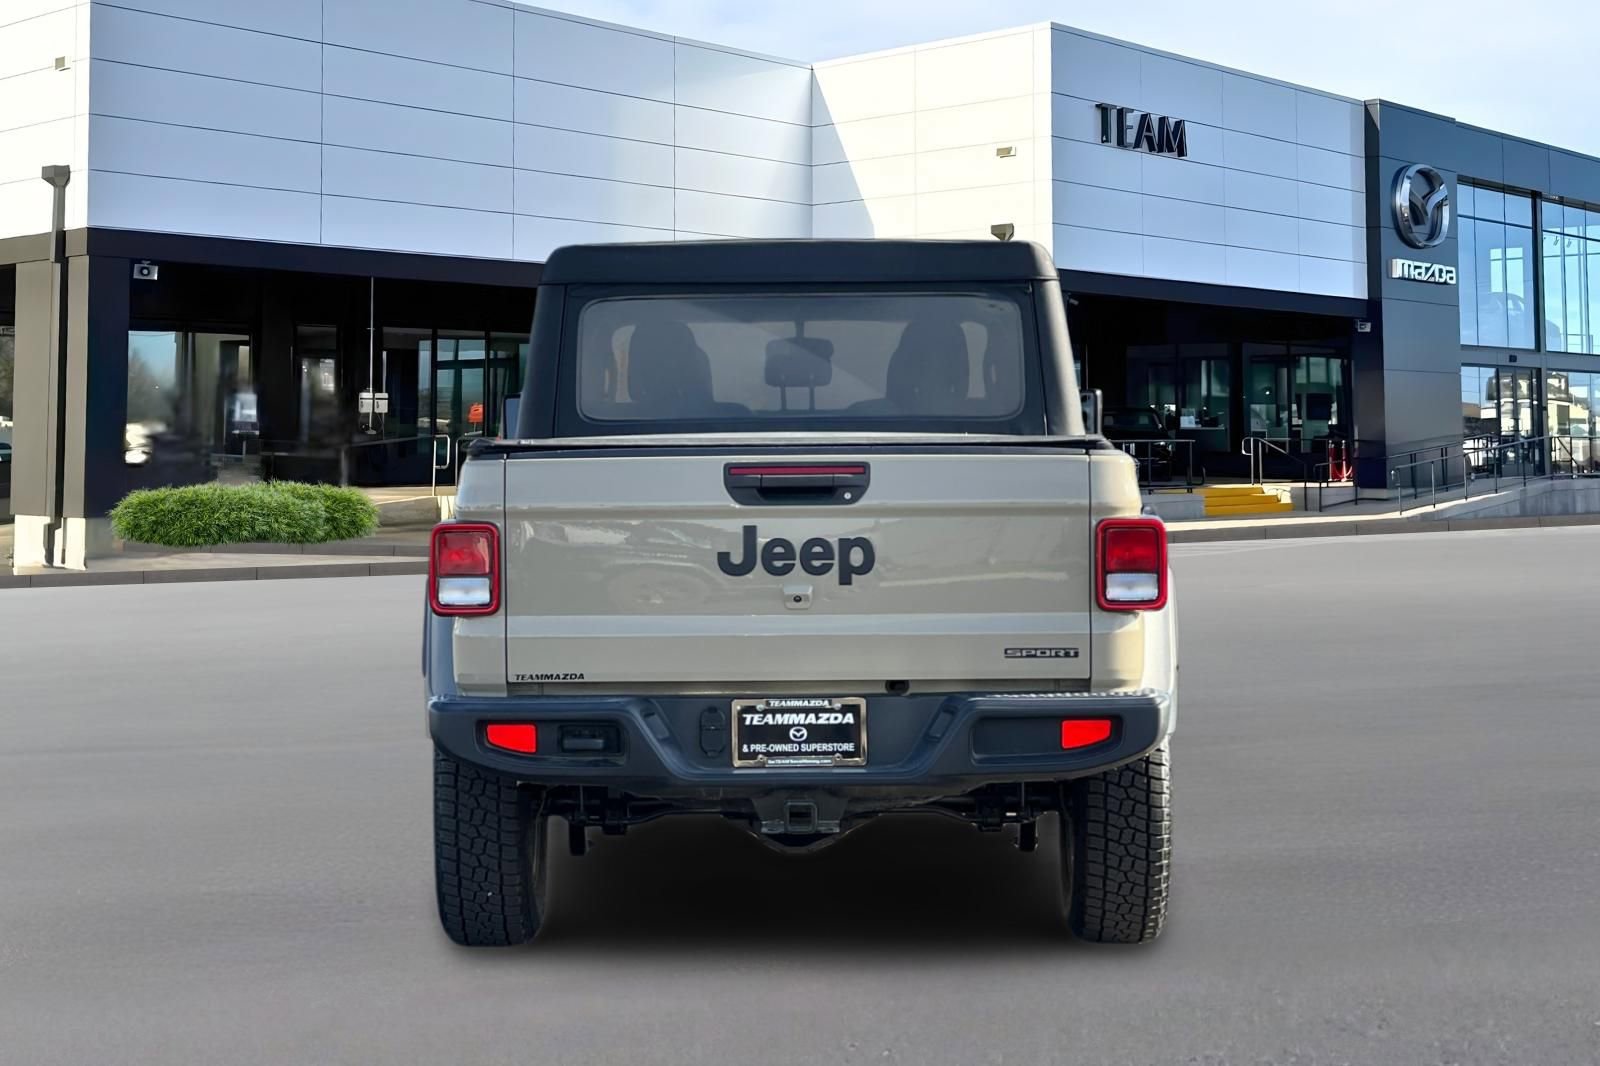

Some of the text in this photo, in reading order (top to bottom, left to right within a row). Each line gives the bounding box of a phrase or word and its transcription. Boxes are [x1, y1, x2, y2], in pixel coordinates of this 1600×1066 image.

[1095, 103, 1187, 157] TEAM
[717, 525, 876, 586] Jeep
[1004, 648, 1079, 658] SPORT
[742, 742, 855, 753] & PRE-OWNED SUPERSTORE
